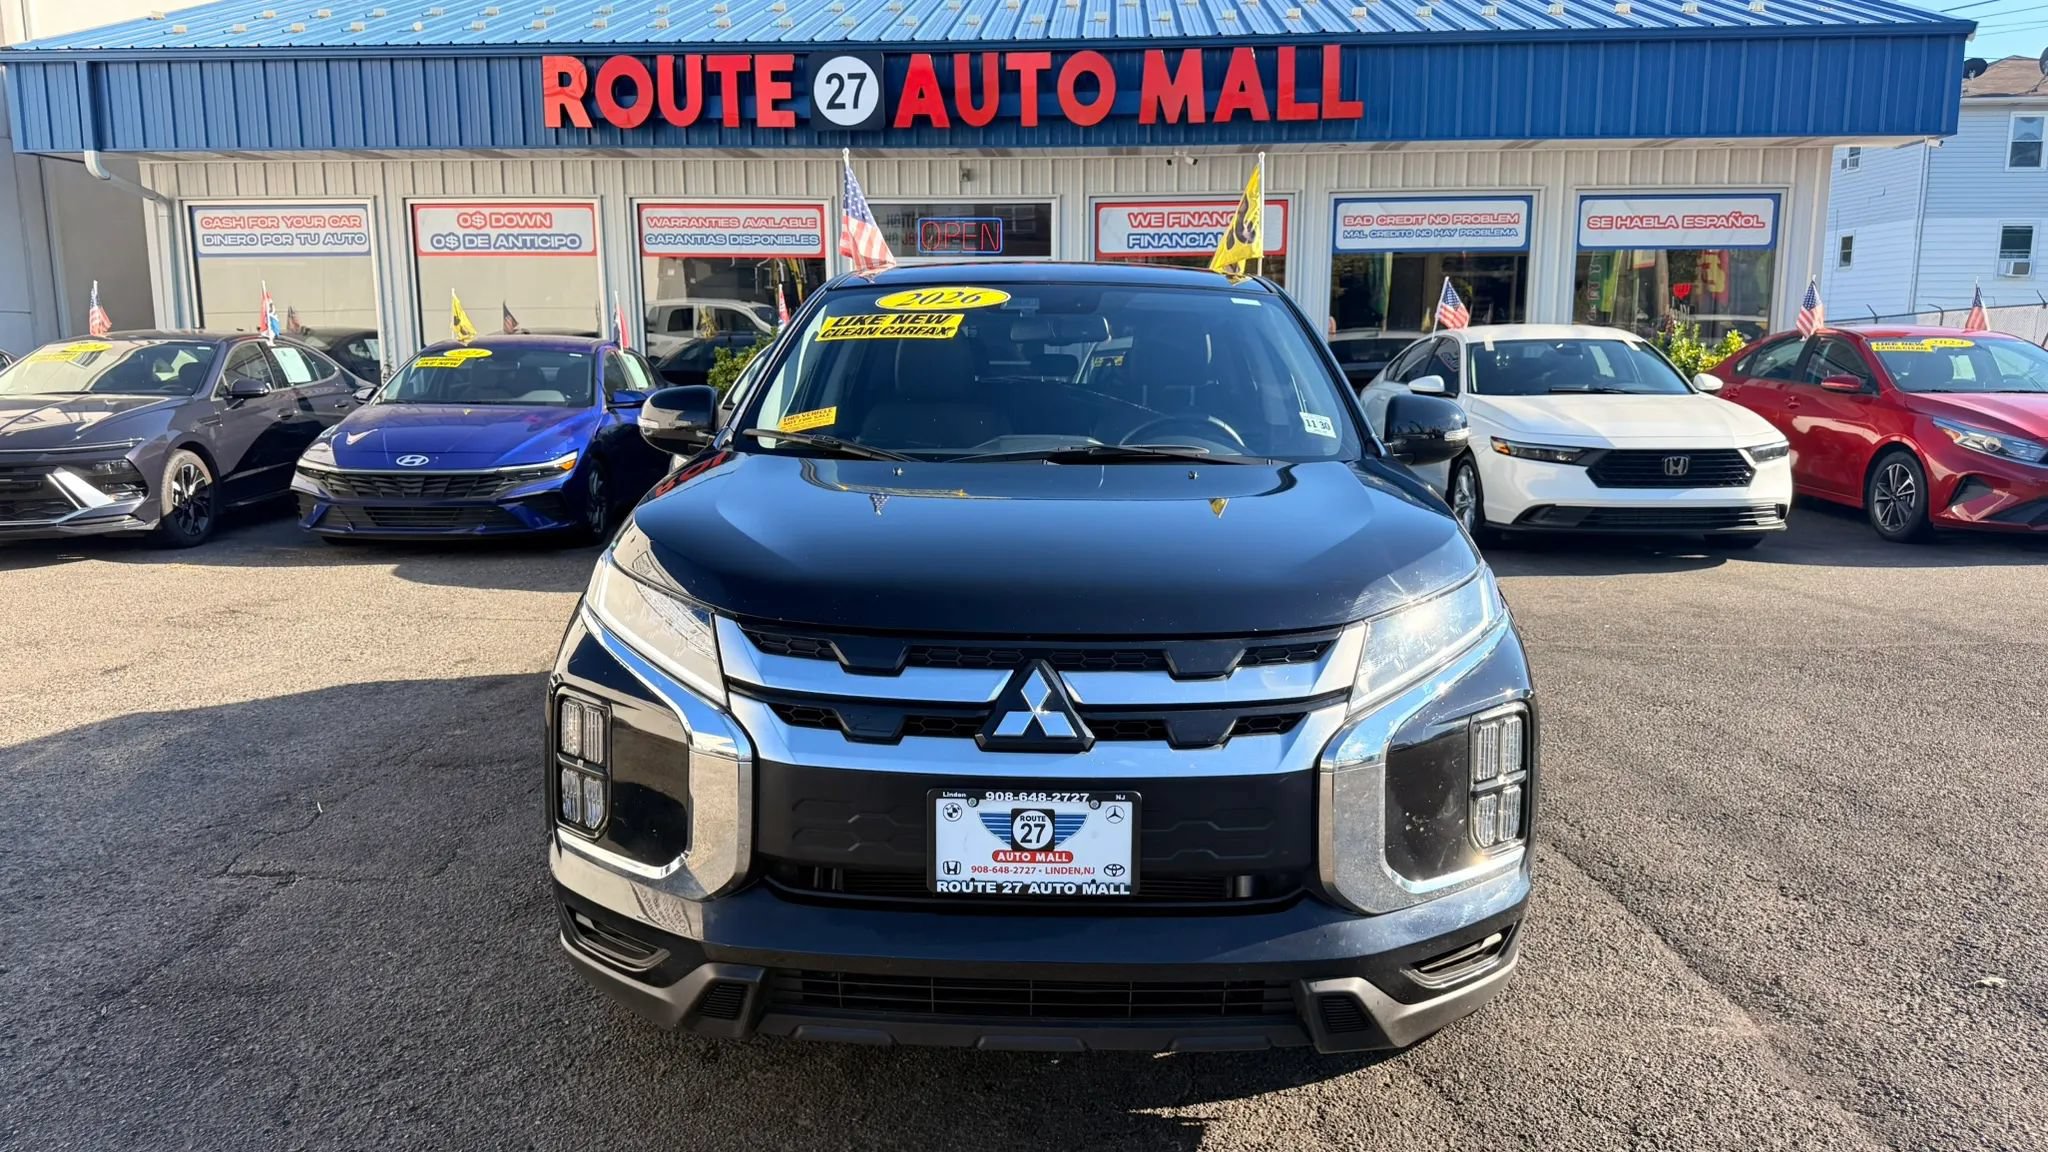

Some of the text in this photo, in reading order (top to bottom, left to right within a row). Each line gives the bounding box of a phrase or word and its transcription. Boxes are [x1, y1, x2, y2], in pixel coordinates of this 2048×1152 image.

[542, 44, 1363, 128] ROUTE 27 AUTO MALL
[200, 215, 362, 230] CASH FOR YOUR CAR
[489, 212, 552, 229] DOWN
[647, 216, 817, 229] WARRANTIES AVAILABLE
[1128, 211, 1236, 229] WE FINANC
[1343, 213, 1520, 226] BAD CREDIT NO PROBLEM
[1587, 211, 1765, 230] SE HABLA ESPAÑOL
[203, 232, 367, 246] DINERO POR TU AUTO
[645, 234, 820, 246] GARANTIAS DISPONIBLES
[921, 221, 1000, 250] OPEN
[1127, 232, 1222, 249] FINANCIA
[1343, 228, 1518, 239] MAL CREDITO NO HAY PROBLEMA
[462, 234, 491, 249] DE
[493, 234, 582, 249] ANTICIPO
[896, 291, 982, 307] 2026
[833, 314, 951, 327] LIKE NEW
[821, 326, 954, 338] CLEAN CARFAX
[1306, 419, 1317, 428] 11
[986, 791, 1089, 803] 908-648-2727
[1020, 823, 1046, 843] 27
[997, 852, 1069, 862] AUTO MALL
[971, 865, 1036, 875] 908-648-2727
[936, 880, 1131, 895] ROUTE 27 AUTO MALL
